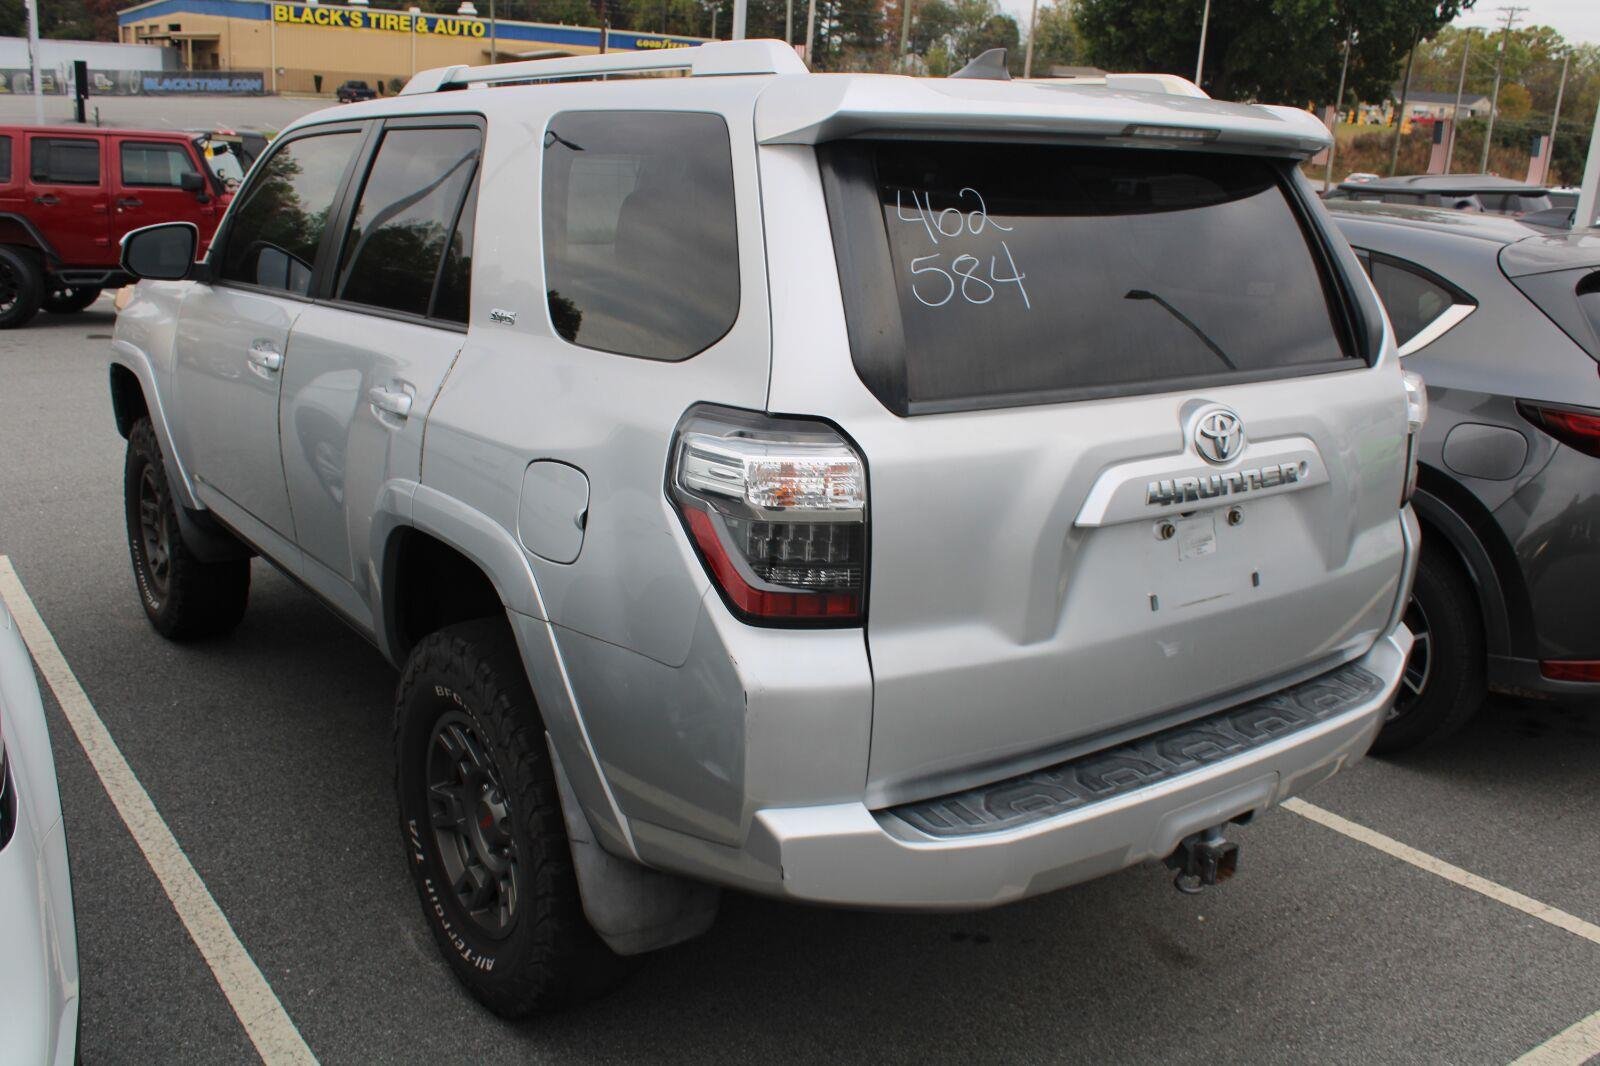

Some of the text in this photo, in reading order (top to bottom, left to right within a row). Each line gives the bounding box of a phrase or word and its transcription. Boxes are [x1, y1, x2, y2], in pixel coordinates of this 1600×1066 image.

[274, 4, 485, 38] BLACK'S TIRE & AUTO
[897, 187, 1014, 244] 462
[910, 240, 1031, 310] 584
[1146, 461, 1298, 506] 4RUNNER
